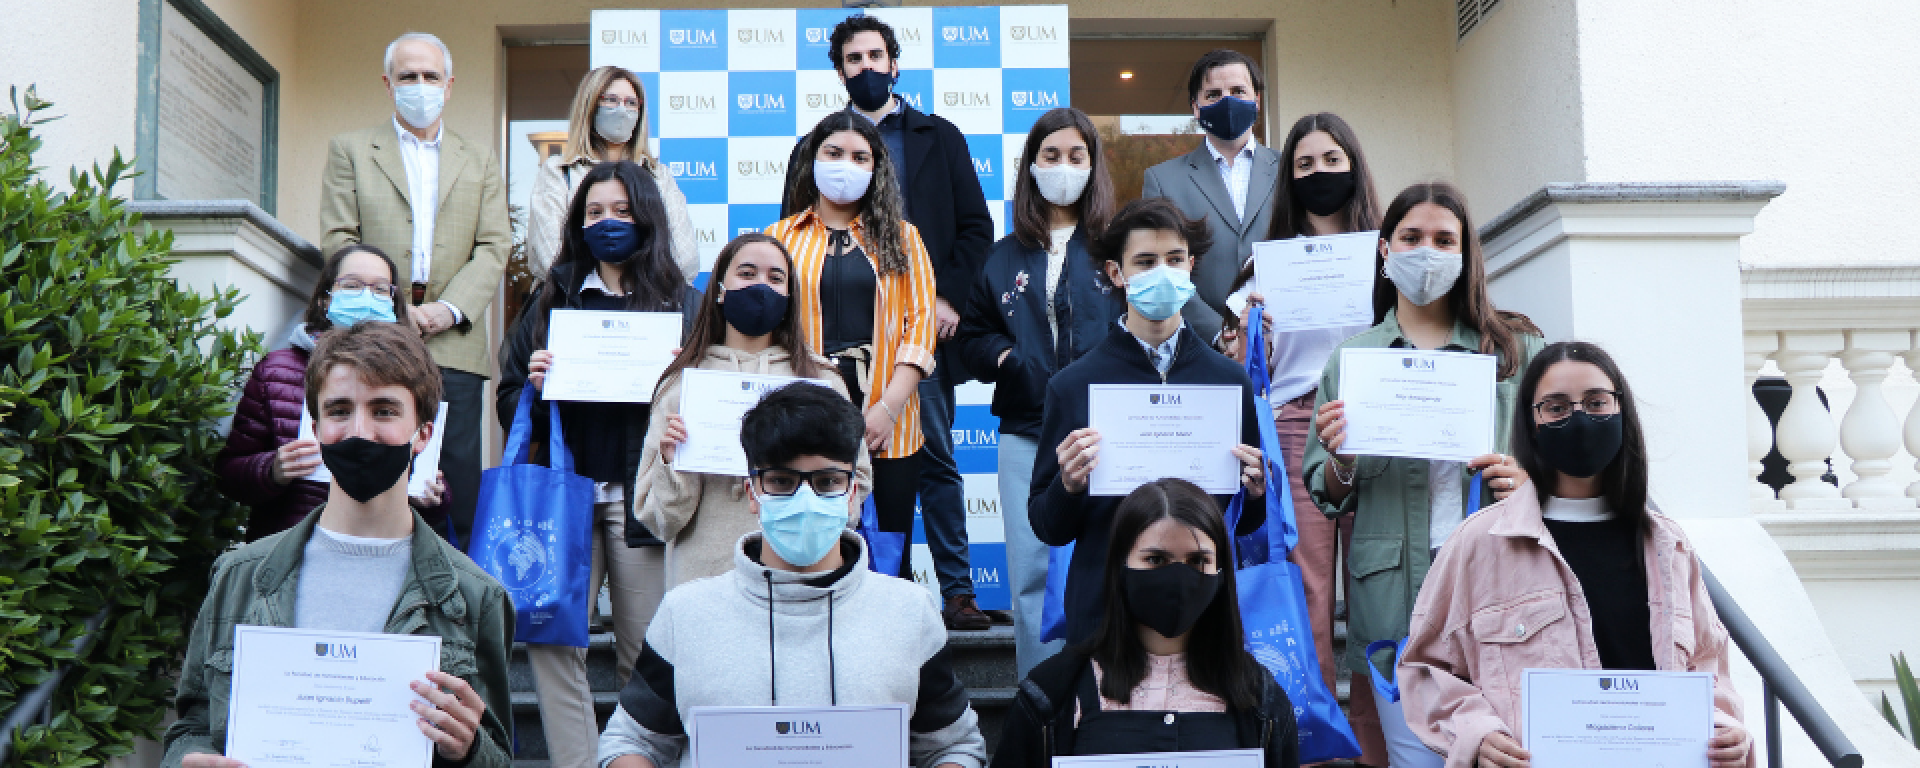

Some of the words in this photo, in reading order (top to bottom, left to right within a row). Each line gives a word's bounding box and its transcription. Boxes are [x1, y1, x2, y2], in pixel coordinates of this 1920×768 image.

[618, 29, 648, 44] UM
[686, 29, 717, 44] UM
[755, 28, 785, 43] UM
[959, 25, 990, 41] UM
[1027, 26, 1057, 41] UM
[686, 95, 716, 110] UM
[755, 94, 785, 109] UM
[961, 91, 990, 107] UM
[1029, 90, 1060, 106] UM
[687, 161, 717, 177] UM
[1161, 393, 1182, 404] UM
[966, 429, 997, 445] UM
[967, 498, 997, 515] UM
[329, 643, 357, 659] UM
[1613, 677, 1639, 691] UM
[791, 720, 822, 735] UM
